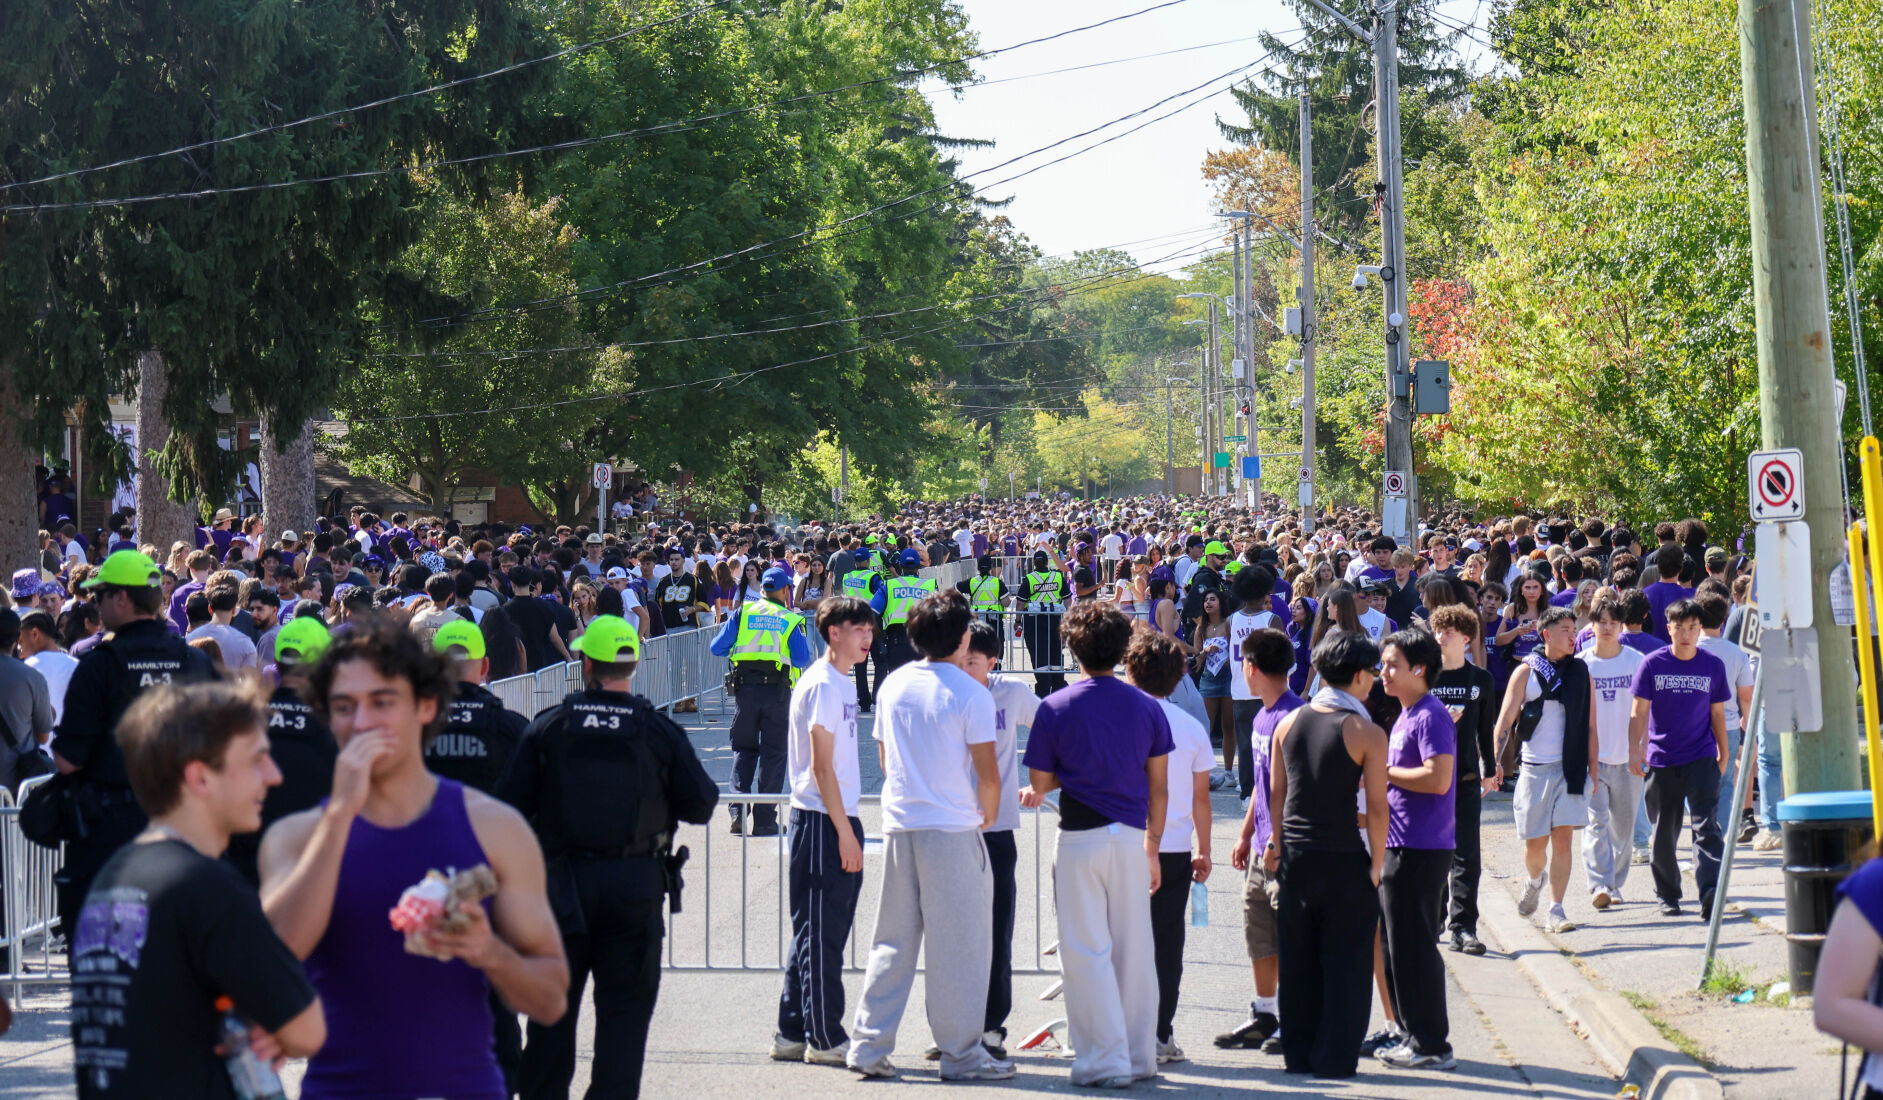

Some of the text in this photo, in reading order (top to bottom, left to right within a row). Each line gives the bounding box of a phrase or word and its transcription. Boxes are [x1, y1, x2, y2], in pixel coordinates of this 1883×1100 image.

[665, 585, 691, 602] 88
[894, 588, 928, 599] POLICE
[755, 616, 782, 624] SPECIAL
[127, 661, 180, 670] HAMILTON
[139, 672, 172, 687] A-3
[1592, 674, 1632, 689] ESTERN
[1654, 674, 1711, 693] WESTERN
[1430, 686, 1466, 696] estern
[573, 704, 633, 715] HAMILTON
[269, 712, 306, 730] A-3
[448, 711, 472, 722] -3
[582, 714, 620, 729] A-3
